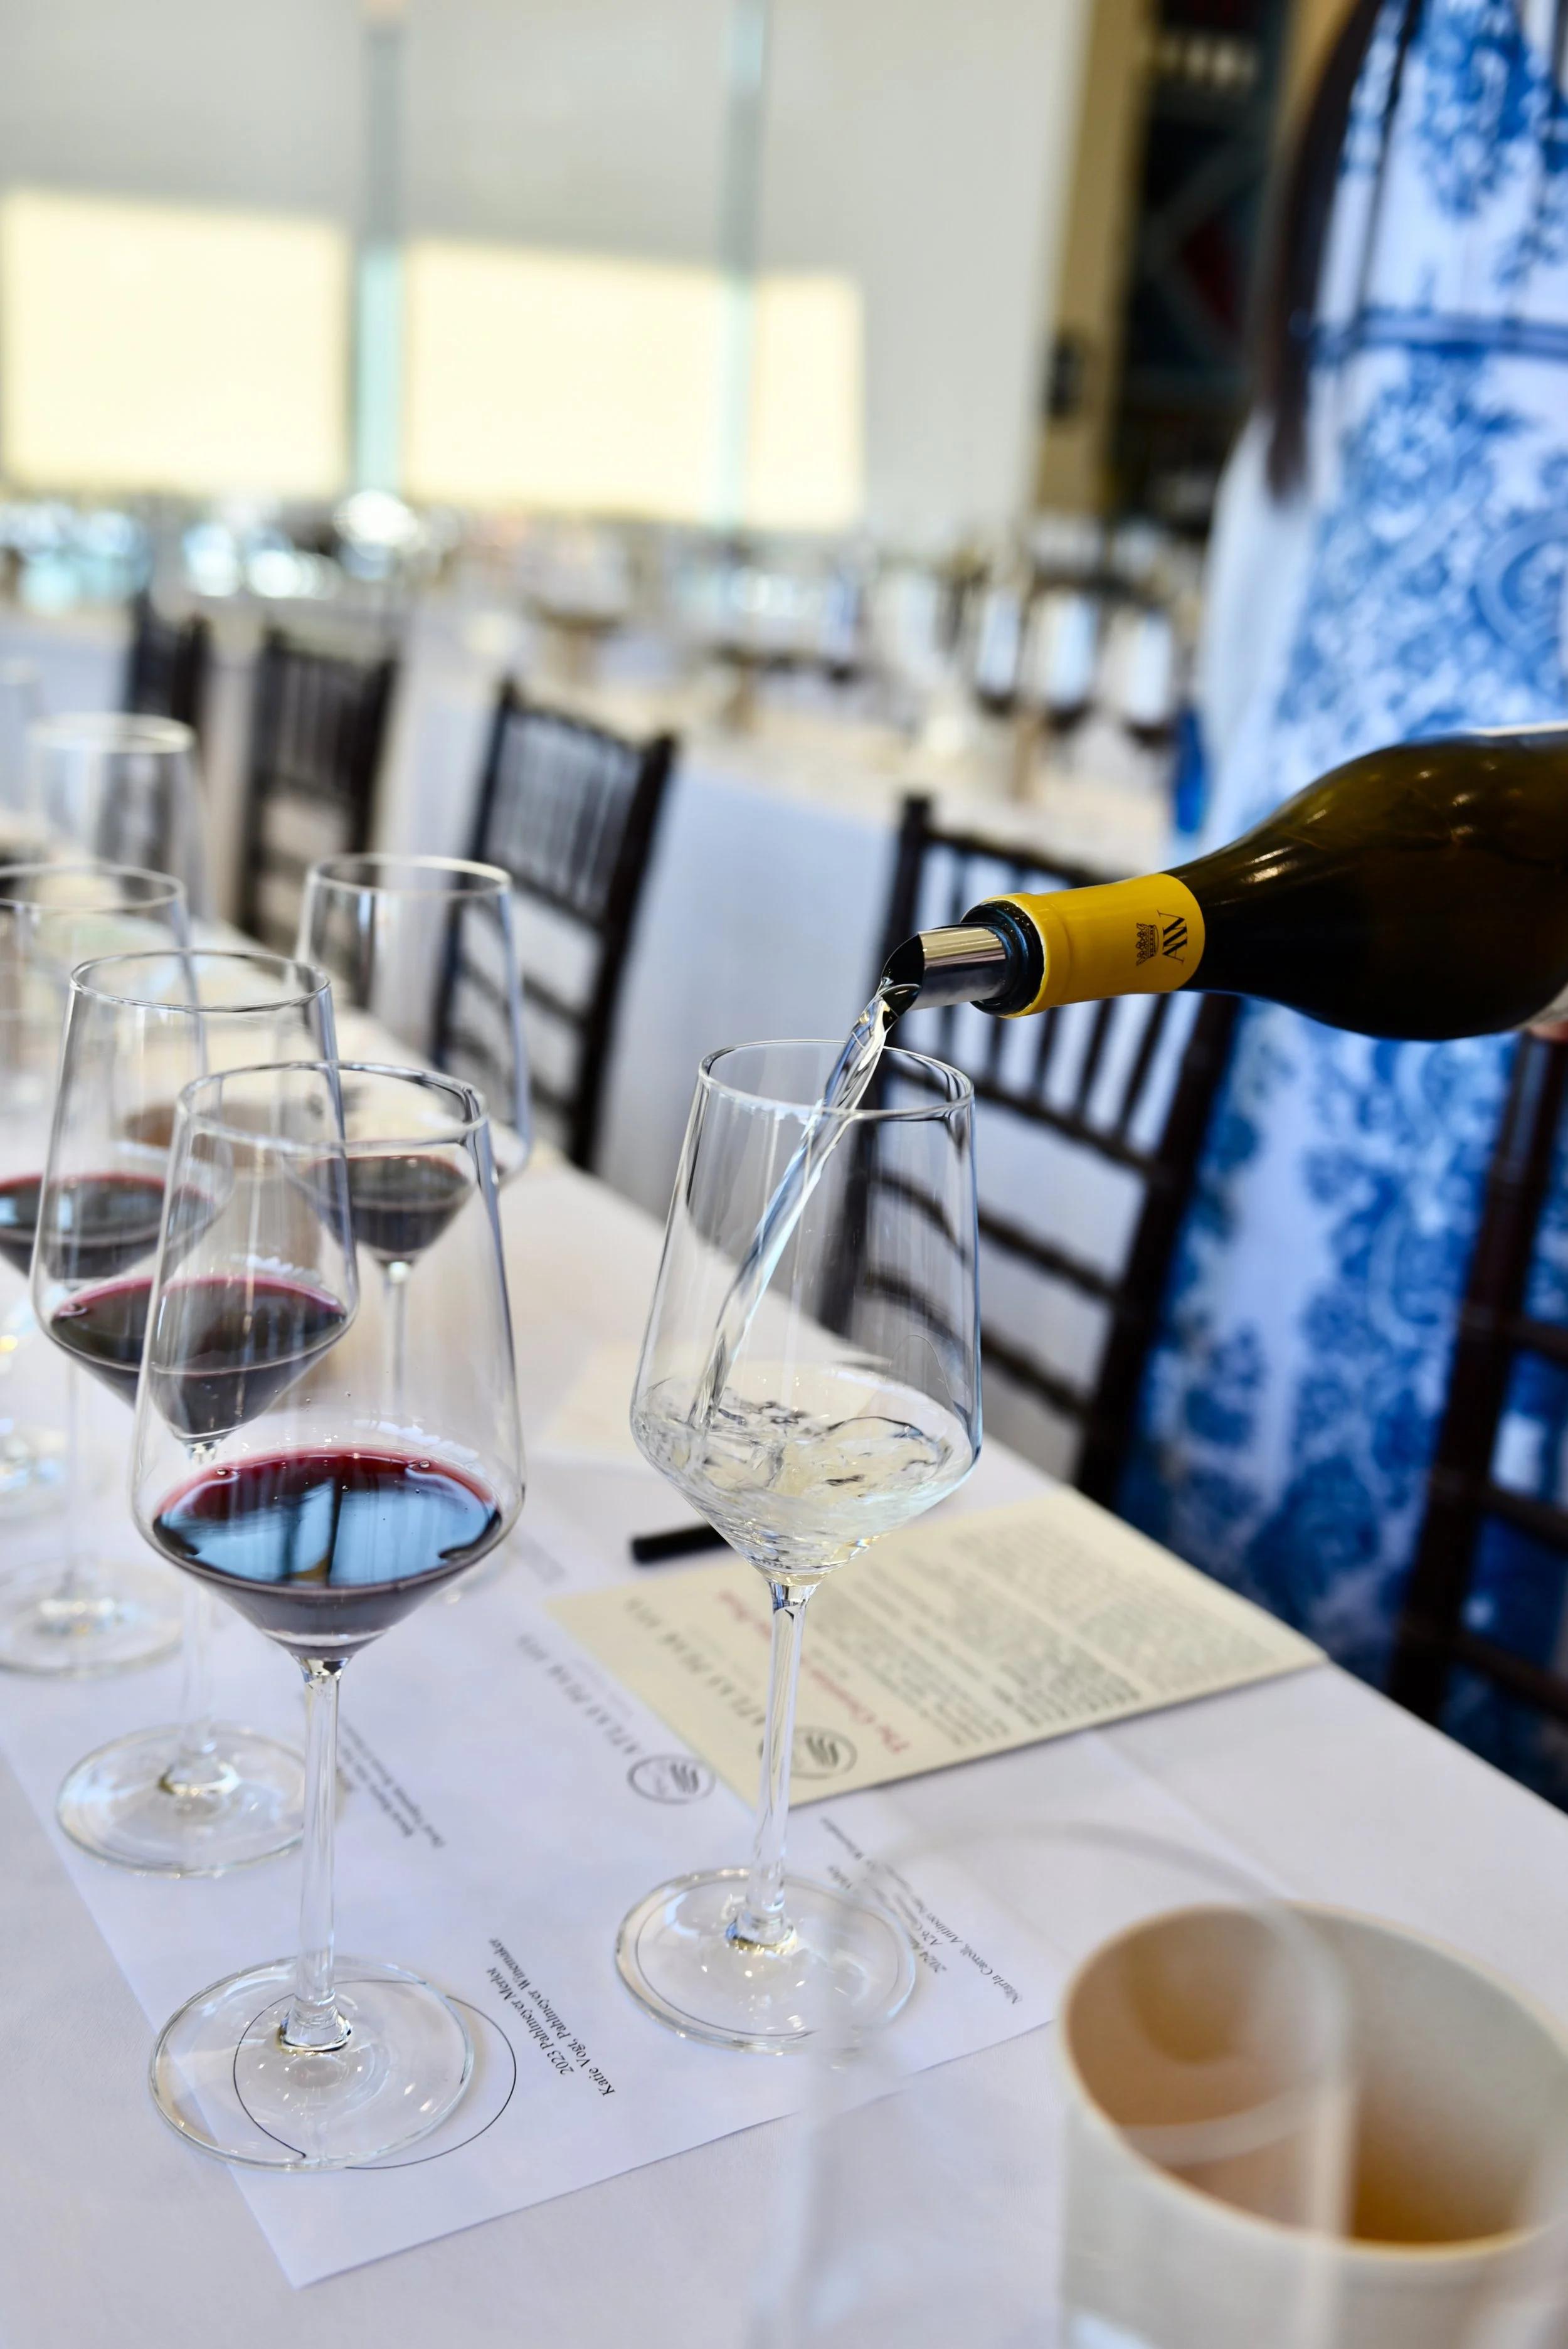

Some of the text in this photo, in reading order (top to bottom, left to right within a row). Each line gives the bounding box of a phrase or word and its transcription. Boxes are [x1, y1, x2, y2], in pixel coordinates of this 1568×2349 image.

[487, 1968, 575, 2075] 2023 Pahlmeyer Merlot
[488, 1938, 616, 2096] Katie Vogt, Pahlmeyer Winemaker
